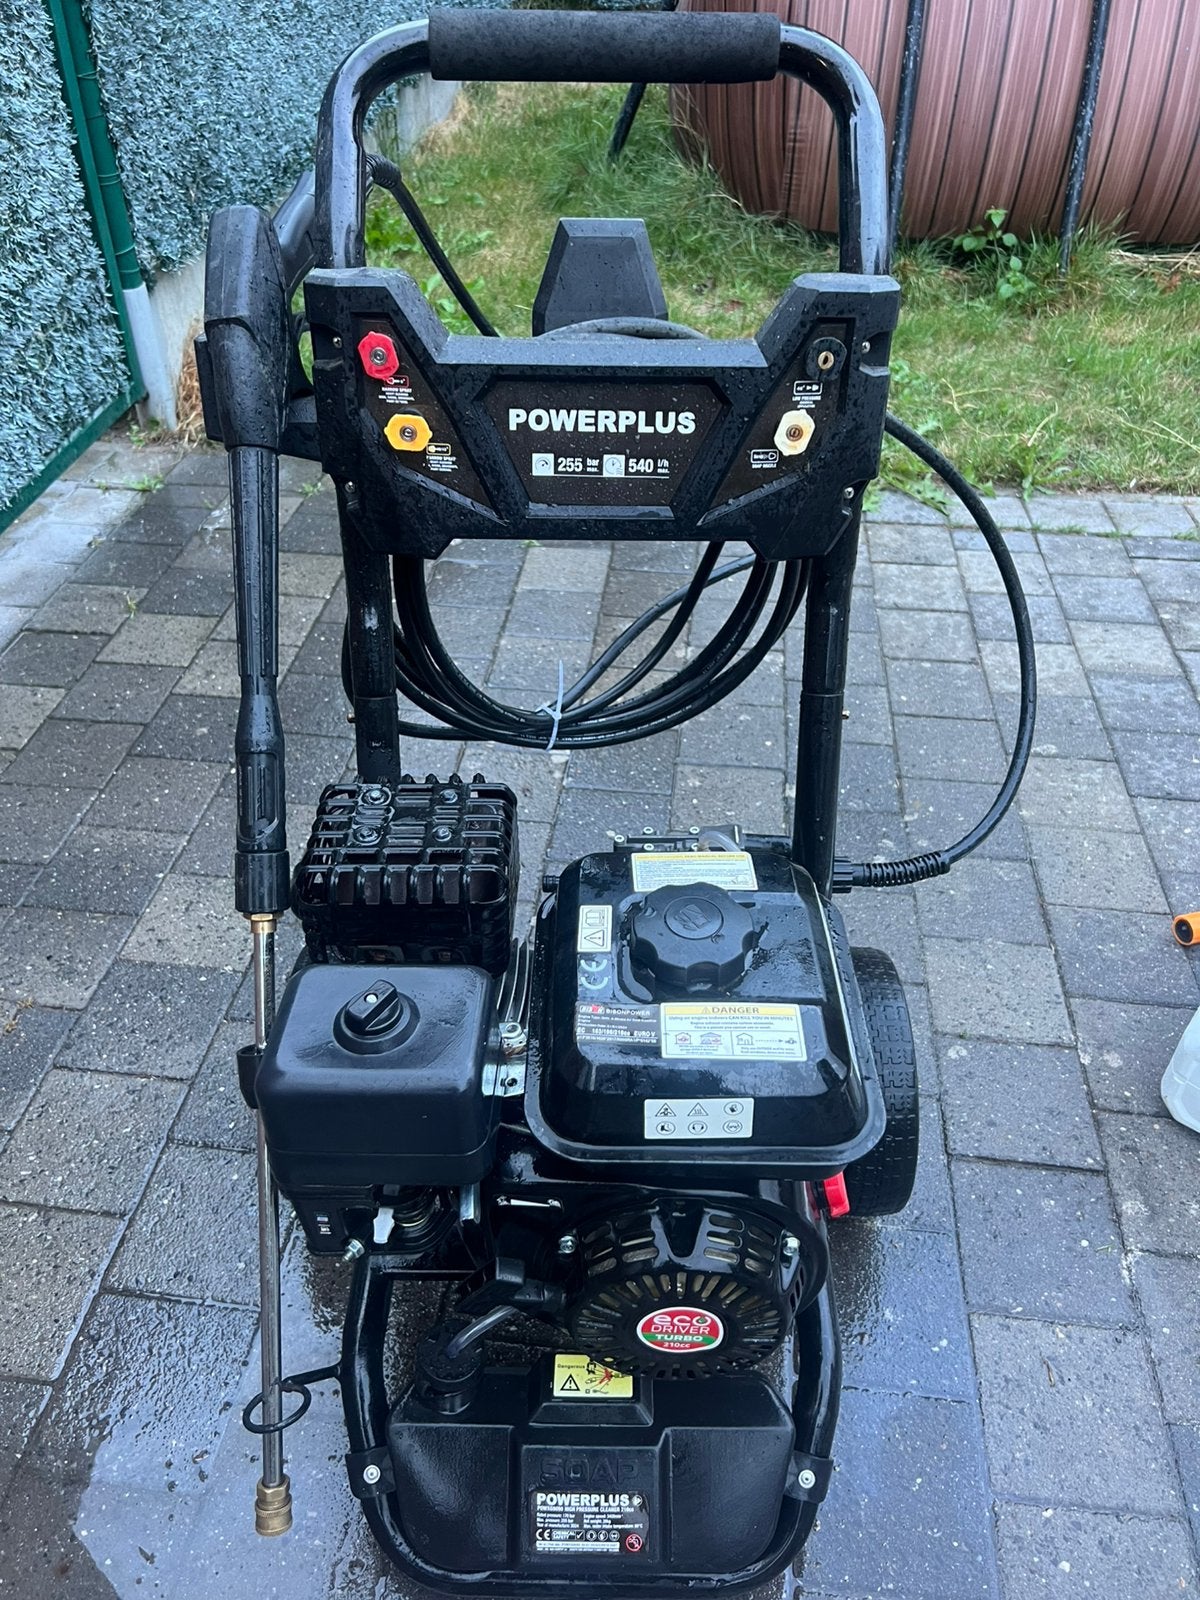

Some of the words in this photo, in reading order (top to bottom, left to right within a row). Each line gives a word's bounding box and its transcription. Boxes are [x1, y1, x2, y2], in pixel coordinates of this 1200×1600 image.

[508, 408, 696, 434] POWERPLUS
[557, 457, 583, 472] 255
[586, 458, 600, 467] bar
[628, 458, 654, 473] 540
[657, 458, 669, 467] l/h
[653, 1314, 712, 1326] eco
[651, 1324, 710, 1334] DRIVER
[540, 1458, 640, 1486] SOAP
[536, 1493, 630, 1506] POWERPLUS
